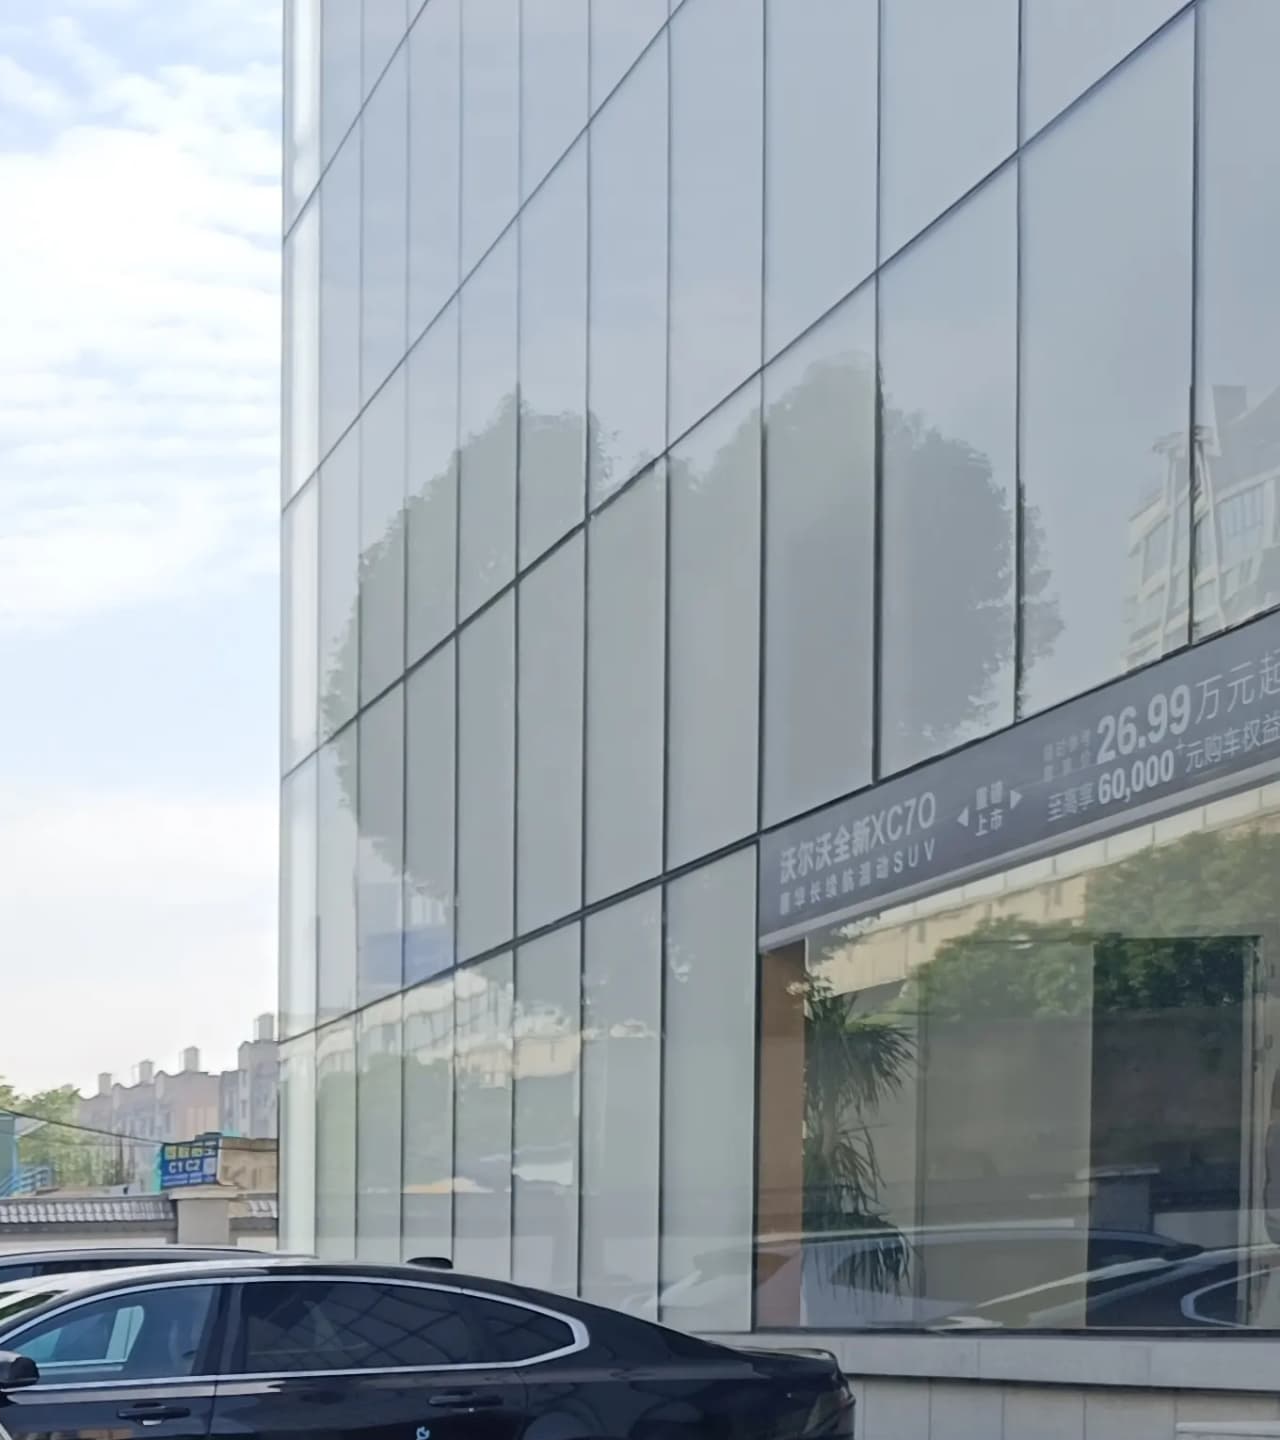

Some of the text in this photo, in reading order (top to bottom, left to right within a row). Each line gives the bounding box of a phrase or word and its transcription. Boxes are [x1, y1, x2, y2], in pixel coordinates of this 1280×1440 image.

[780, 792, 937, 884] 沃尔沃全新XC70
[169, 1161, 183, 1174] C1
[185, 1160, 201, 1172] C2
